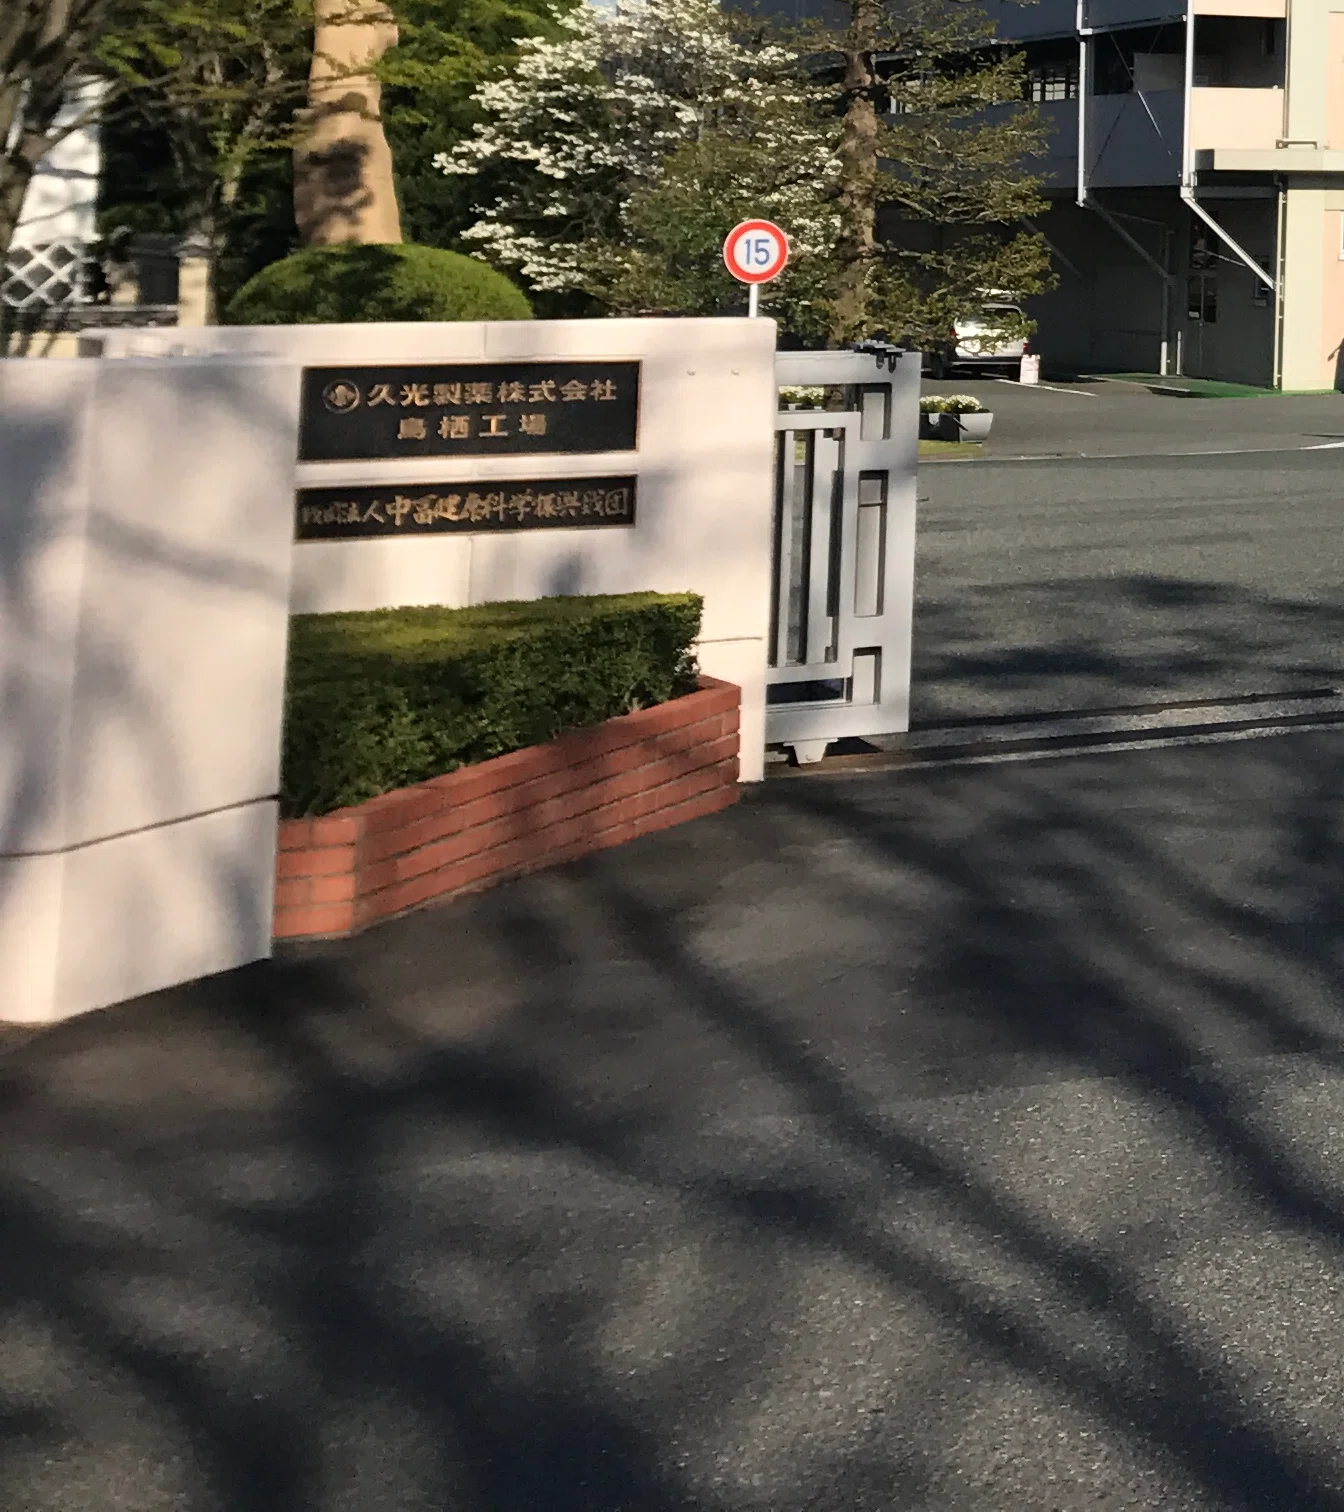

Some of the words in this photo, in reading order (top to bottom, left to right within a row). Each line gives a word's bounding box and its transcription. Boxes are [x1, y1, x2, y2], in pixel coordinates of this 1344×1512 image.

[745, 239, 770, 265] 15
[367, 379, 617, 407] 久光製薬株式会社
